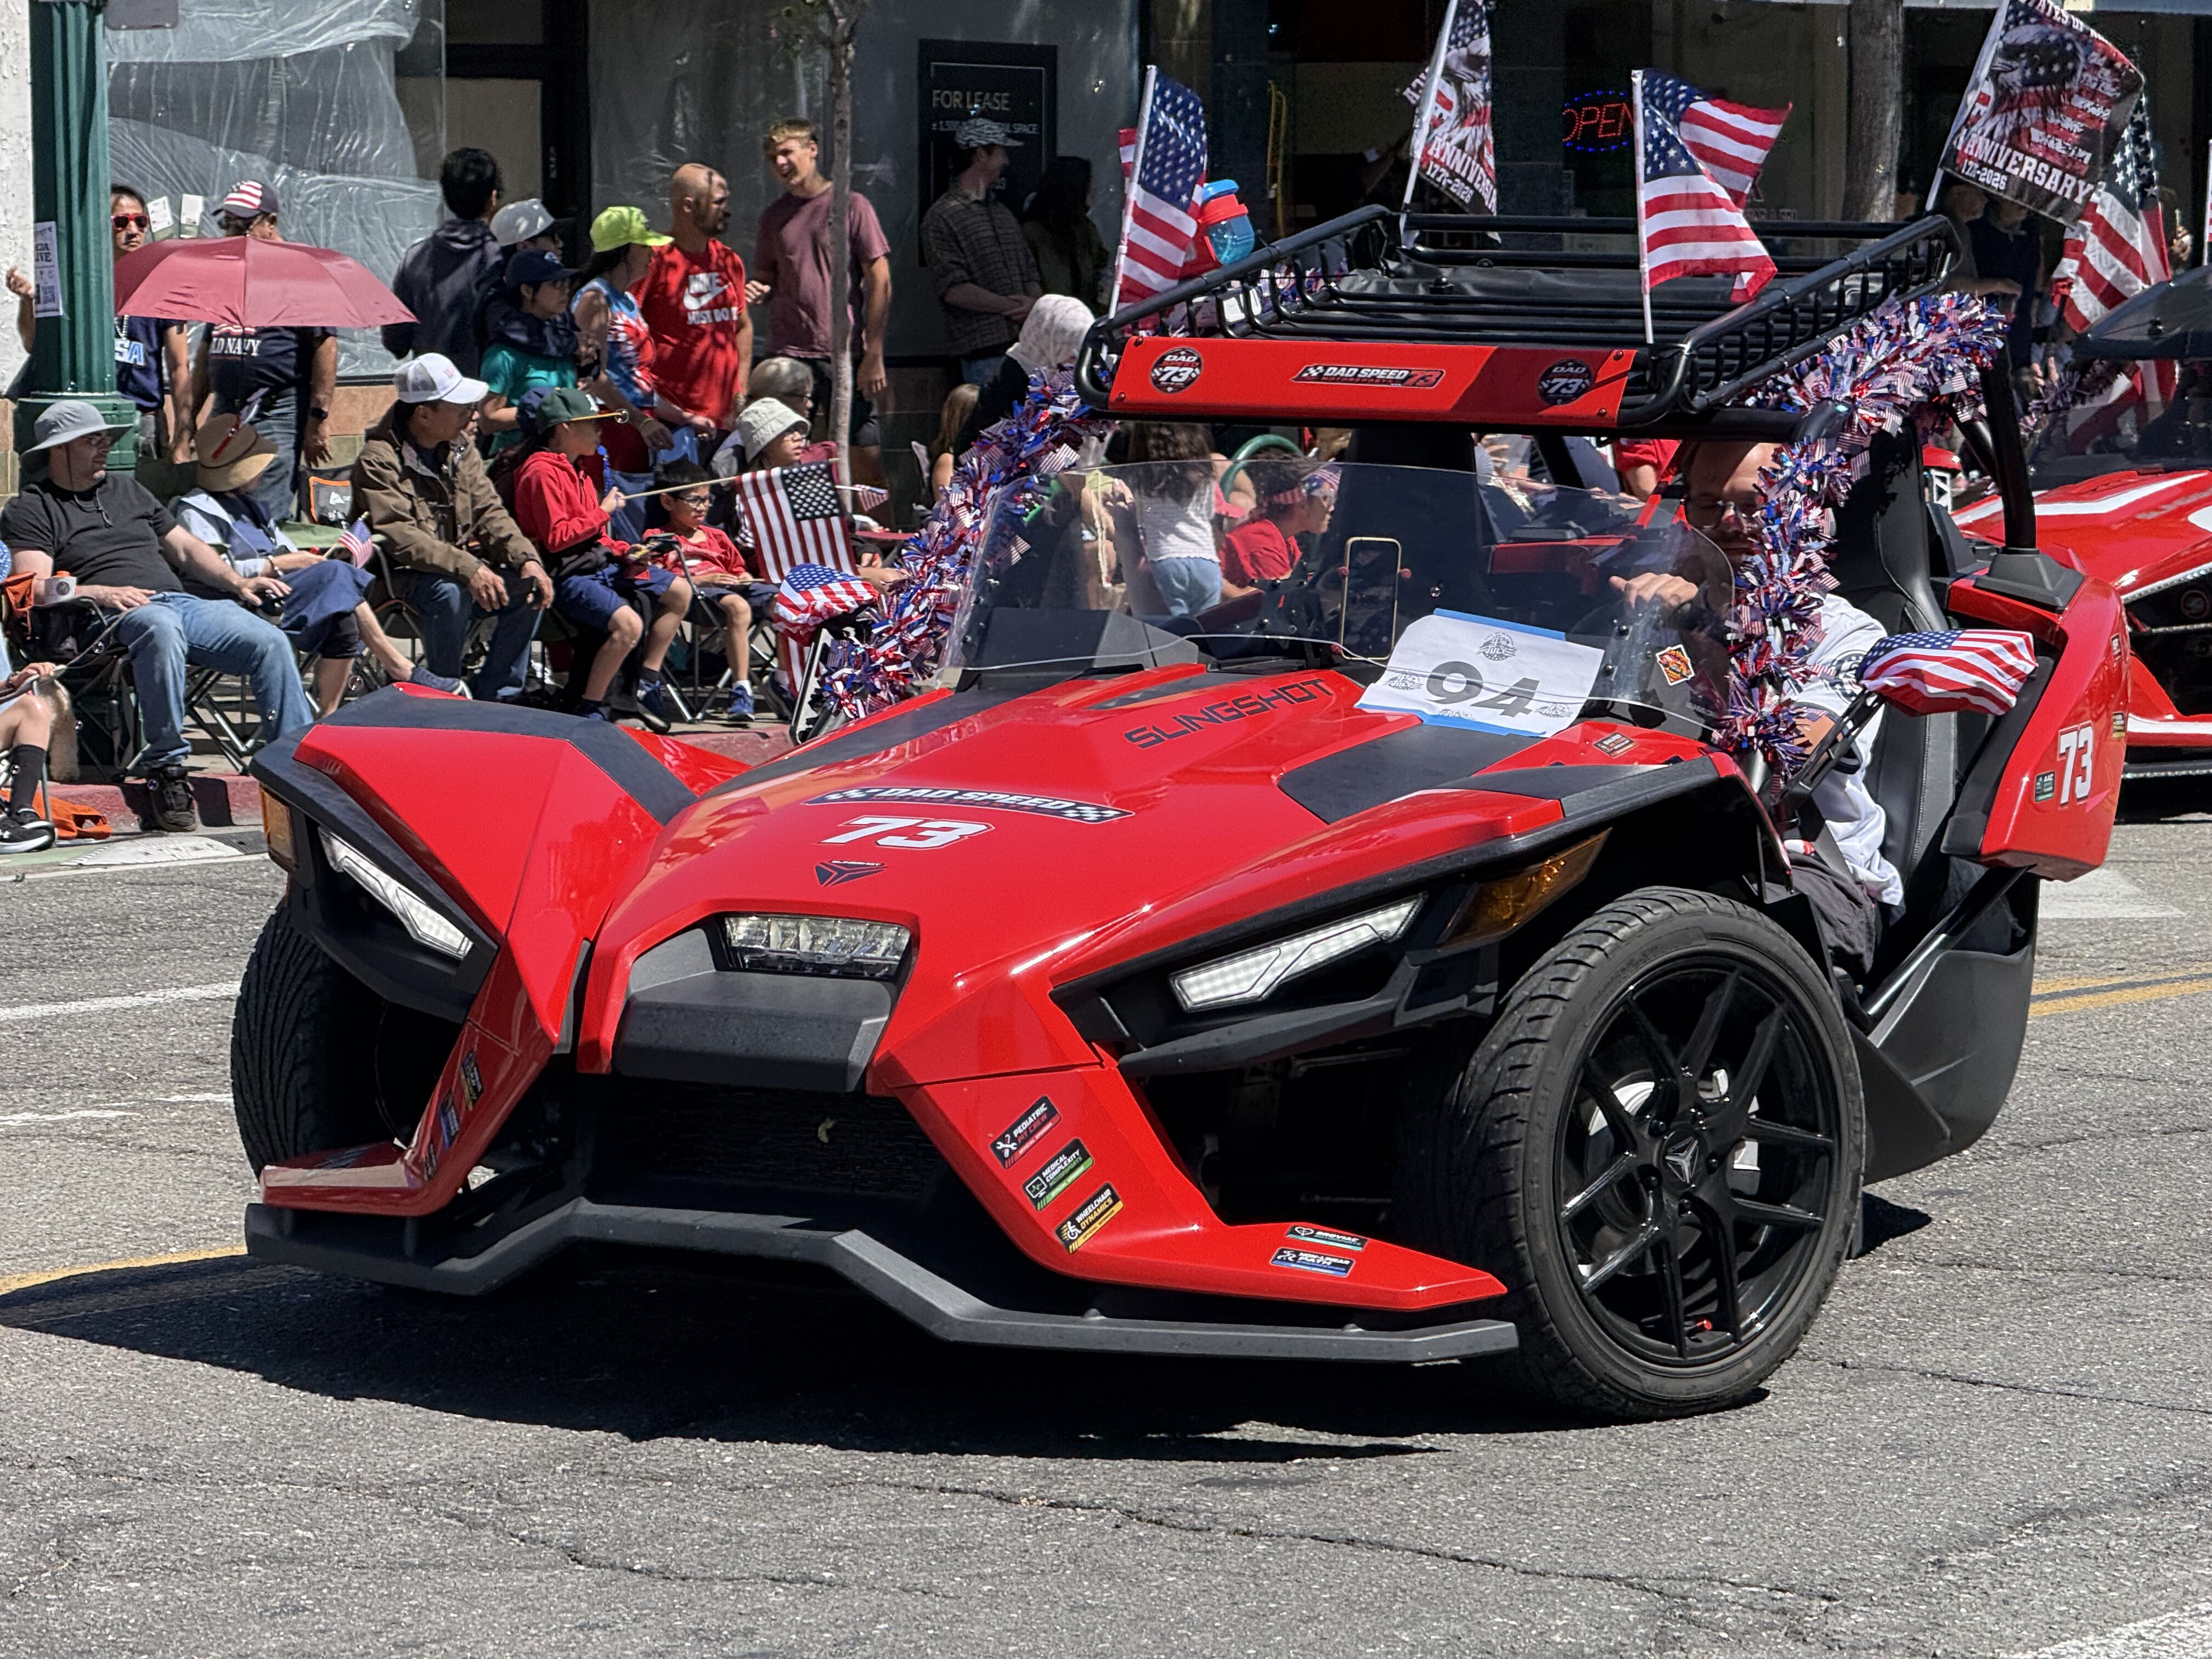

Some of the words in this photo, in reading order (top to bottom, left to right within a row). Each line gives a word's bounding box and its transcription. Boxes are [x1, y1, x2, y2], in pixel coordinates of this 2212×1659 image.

[932, 89, 963, 109] FOR
[966, 91, 1011, 111] LEASE
[1963, 133, 2094, 204] ANNIVERSARY
[686, 309, 713, 325] JUST
[713, 307, 730, 322] DO
[114, 338, 144, 366] SA
[225, 337, 262, 356] NAVY
[1158, 366, 1194, 382] 73
[1324, 366, 1355, 377] DAD
[1357, 369, 1409, 380] SPEED
[1402, 370, 1441, 386] 73
[1547, 378, 1583, 394] 73
[1484, 646, 1506, 654] JULY
[1489, 635, 1509, 648] 4TH
[1423, 661, 1540, 718] 94
[1124, 678, 1333, 749] SLINGSHOT
[2059, 725, 2094, 805] 73
[878, 788, 960, 798] DAD
[952, 792, 1077, 810] SPEED
[820, 816, 990, 849] 73
[1013, 1102, 1048, 1138] PEDIATRIC
[1017, 1129, 1028, 1143] PIT
[1028, 1112, 1048, 1135] CREW
[1042, 1153, 1068, 1178] MEDICAL
[1046, 1149, 1081, 1183] COMPLEXITY
[1075, 1188, 1112, 1224] WHEELCHAIR
[1080, 1197, 1113, 1230] DYNAMICS
[1298, 1256, 1332, 1266] PATH
